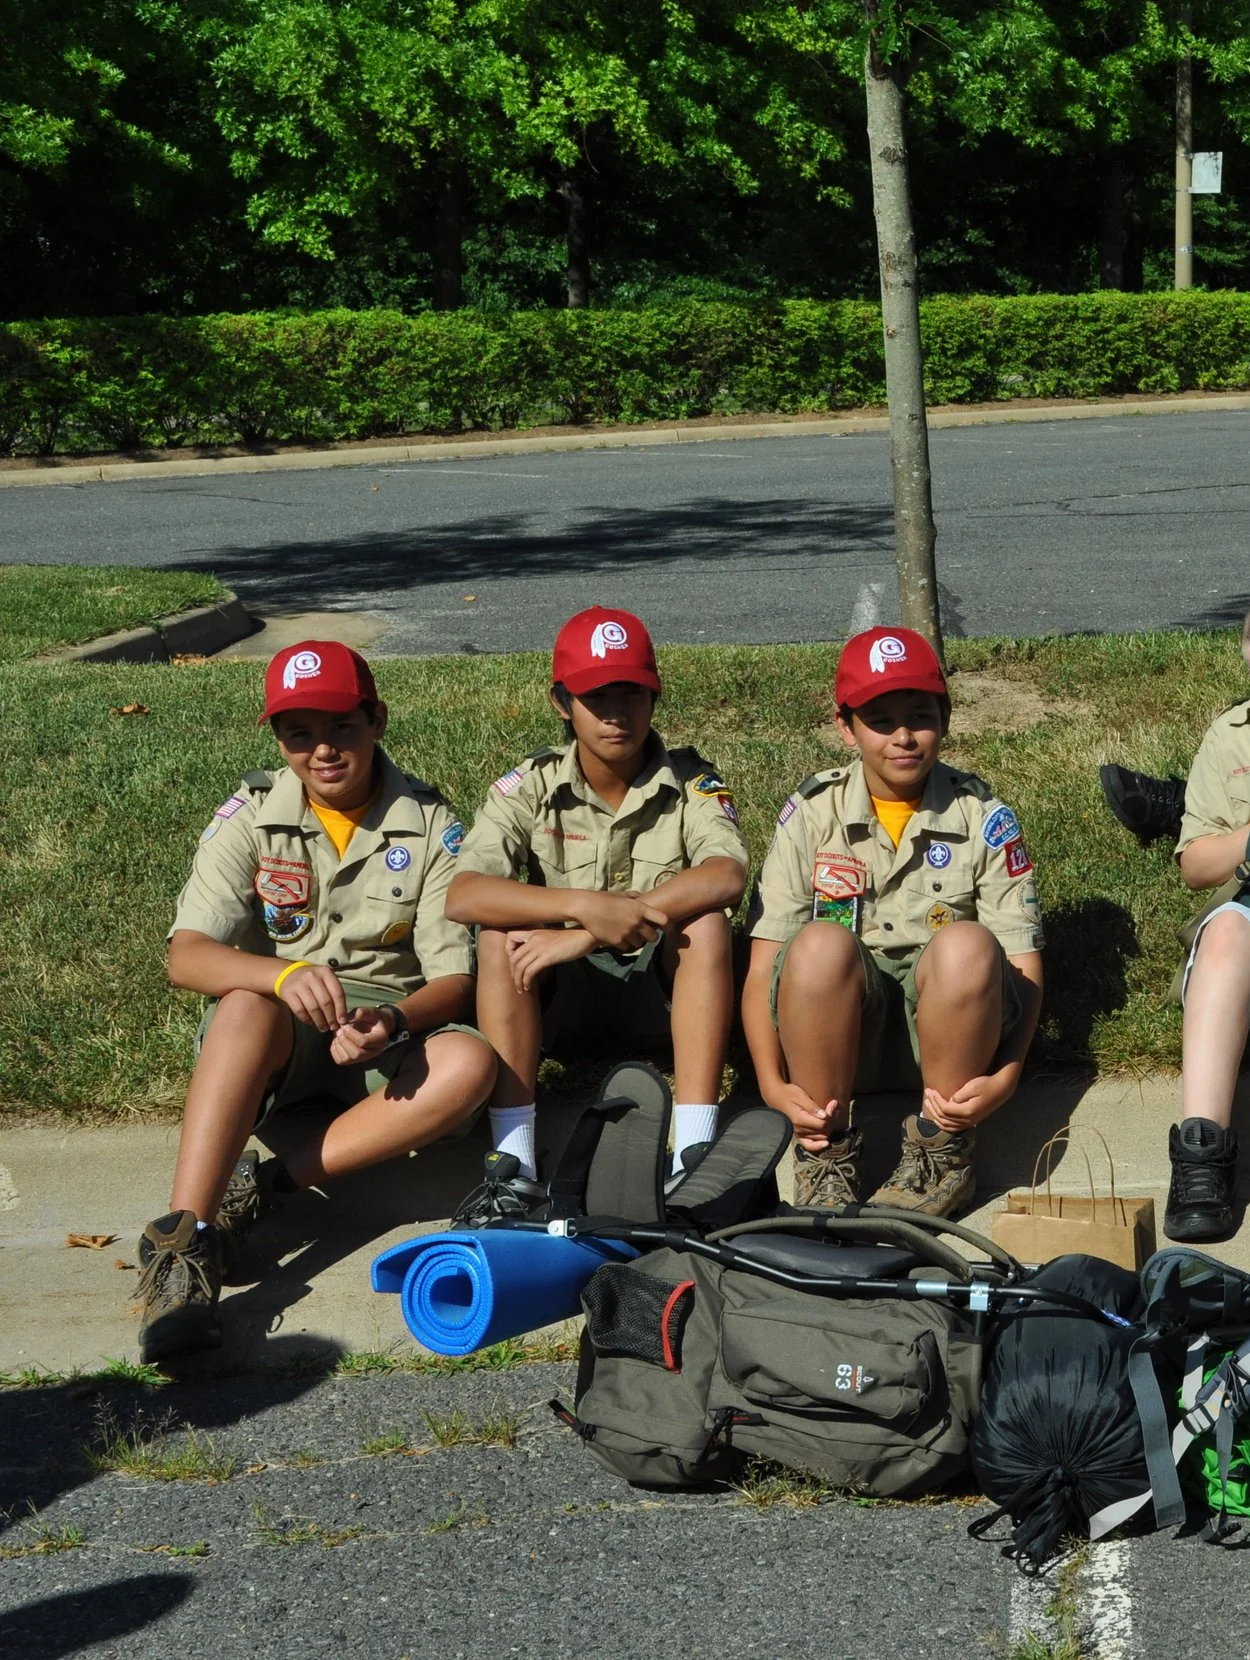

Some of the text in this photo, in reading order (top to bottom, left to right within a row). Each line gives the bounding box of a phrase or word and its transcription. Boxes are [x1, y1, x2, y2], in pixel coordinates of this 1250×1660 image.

[604, 624, 622, 641] G
[880, 640, 901, 655] G
[296, 654, 315, 670] G
[835, 1364, 852, 1390] 63
